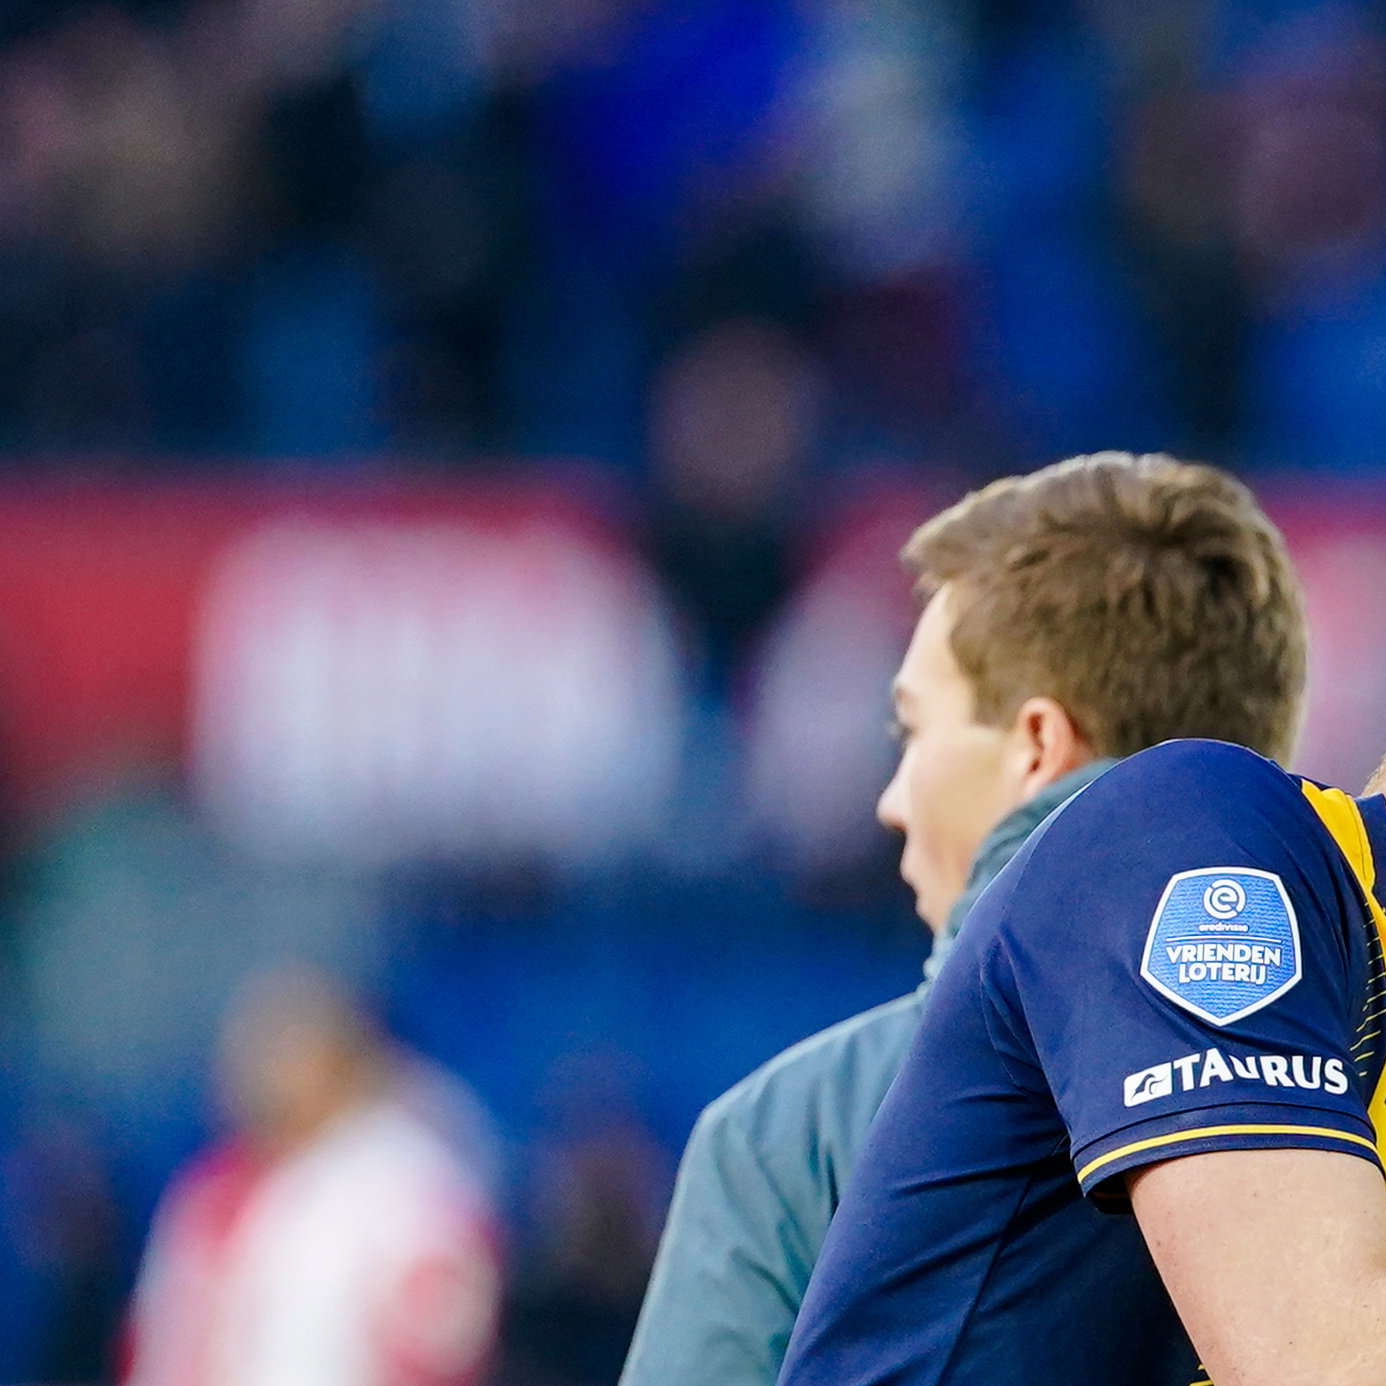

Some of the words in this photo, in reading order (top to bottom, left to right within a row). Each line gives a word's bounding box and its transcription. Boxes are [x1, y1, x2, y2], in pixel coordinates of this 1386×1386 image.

[1165, 943, 1282, 967] VRIENDEN
[1178, 962, 1266, 985] LOTERIJ
[1174, 1047, 1348, 1095] TAURUS
